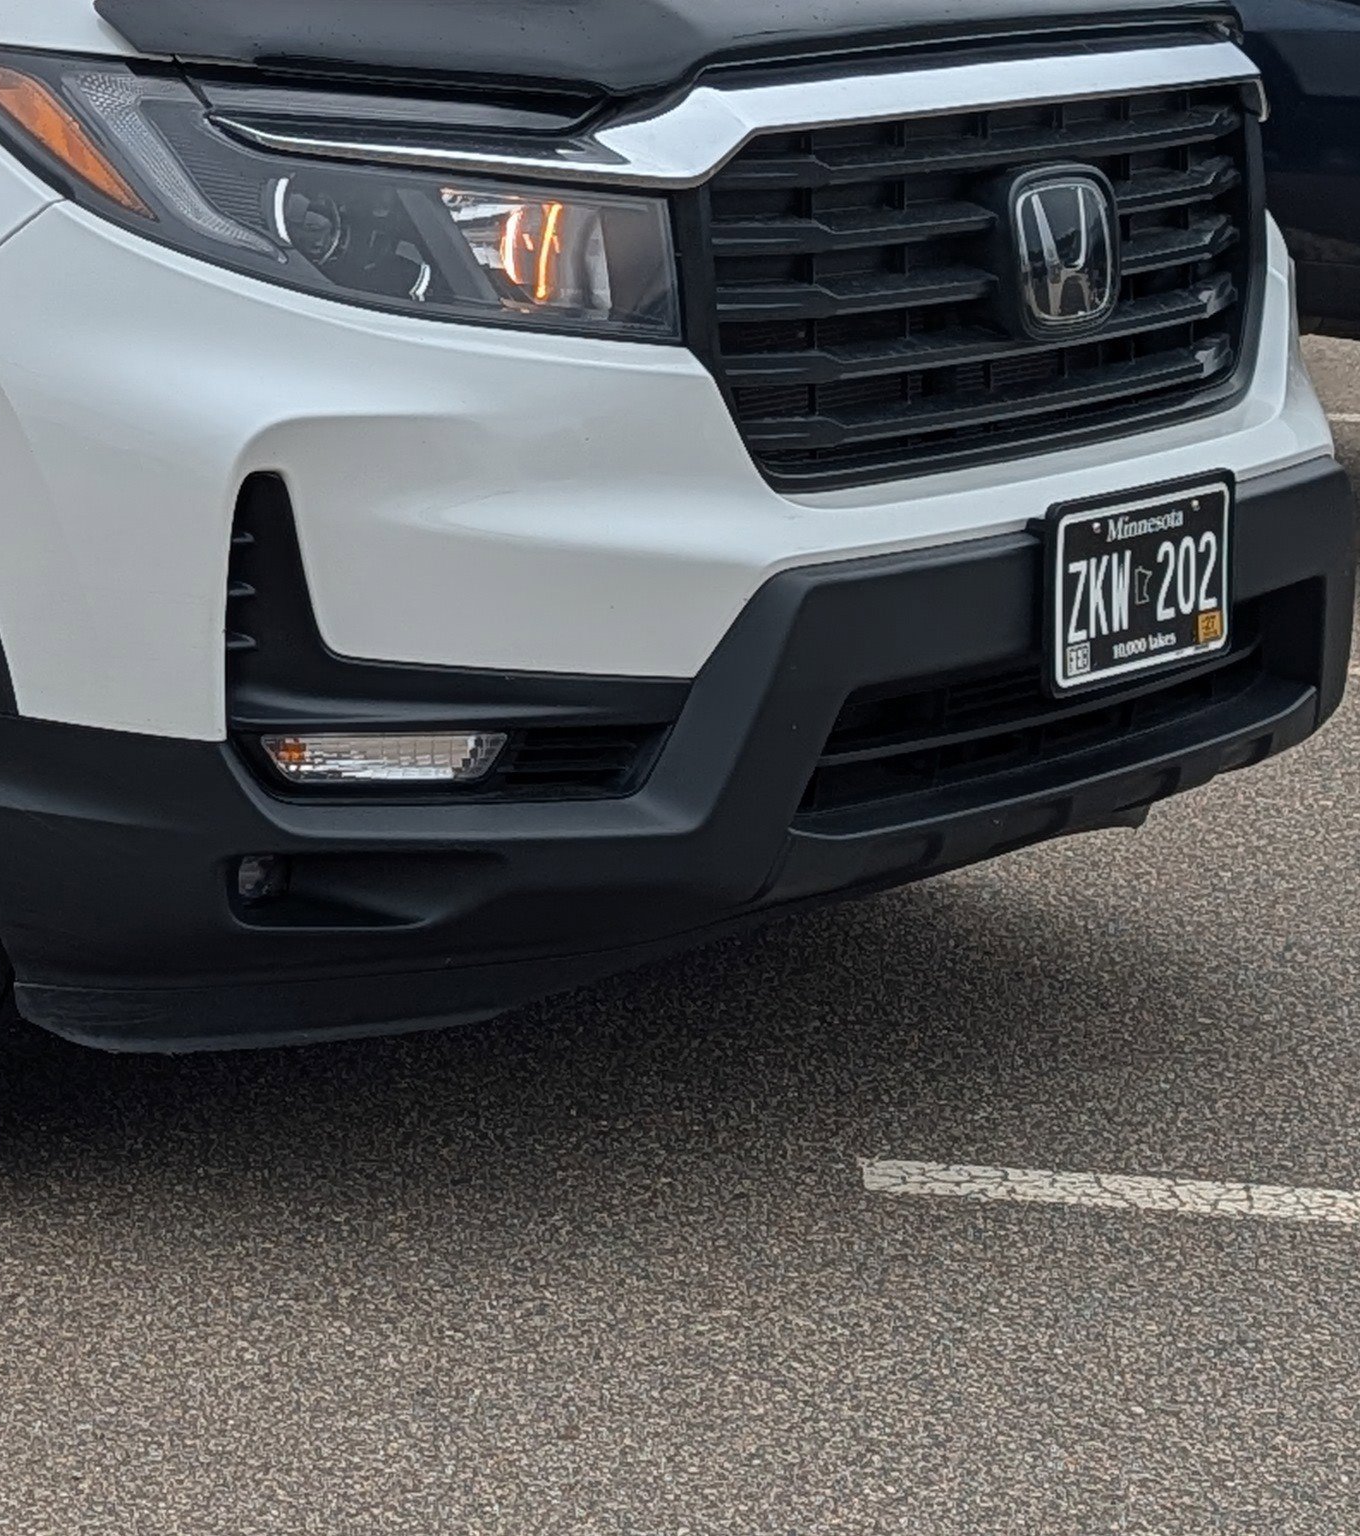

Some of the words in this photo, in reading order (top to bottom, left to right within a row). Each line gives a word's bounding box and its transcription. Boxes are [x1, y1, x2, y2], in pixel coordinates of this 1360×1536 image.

[1106, 509, 1184, 543] Minnesota
[1067, 549, 1132, 644] ZKW
[1155, 530, 1218, 621] 202
[1112, 637, 1147, 660] 10,000
